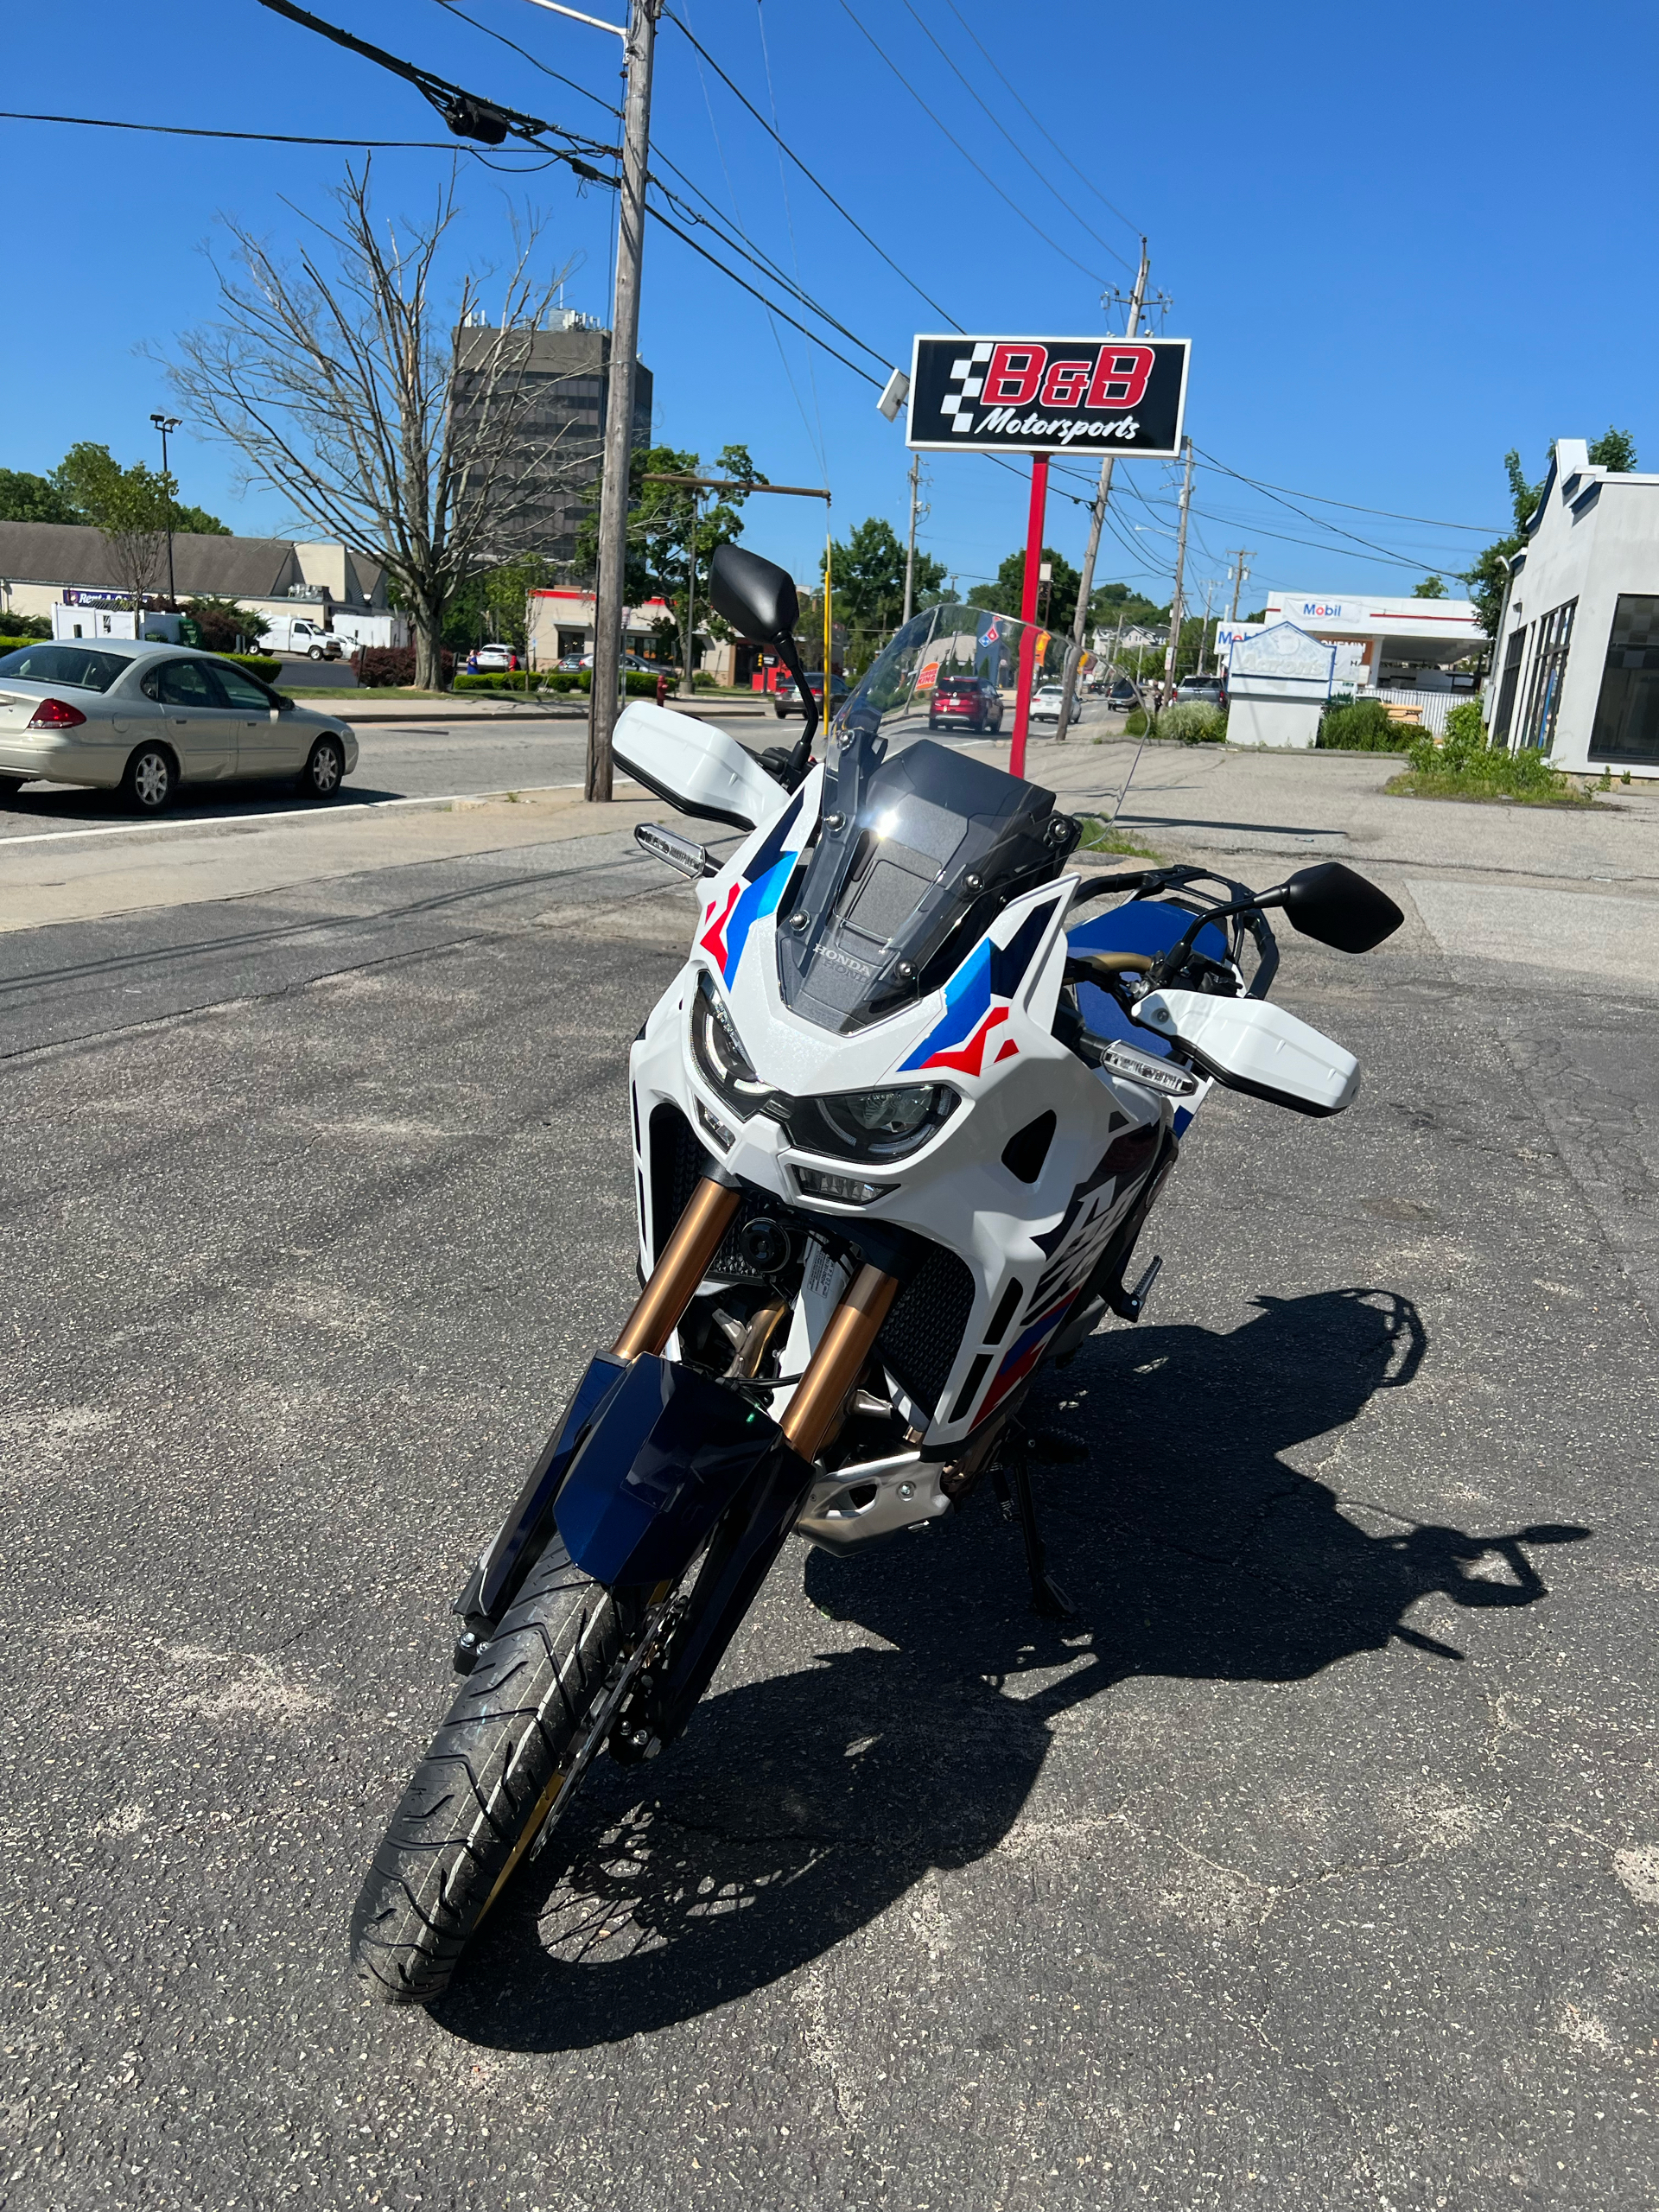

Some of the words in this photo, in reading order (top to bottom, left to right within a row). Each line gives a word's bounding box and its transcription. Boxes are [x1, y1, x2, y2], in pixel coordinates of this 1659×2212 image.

[980, 343, 1155, 409] B&B
[974, 407, 1141, 445] Motorsports
[1303, 604, 1342, 617] Mobil
[1236, 652, 1325, 677] Aaron's
[813, 943, 870, 976] HONDA
